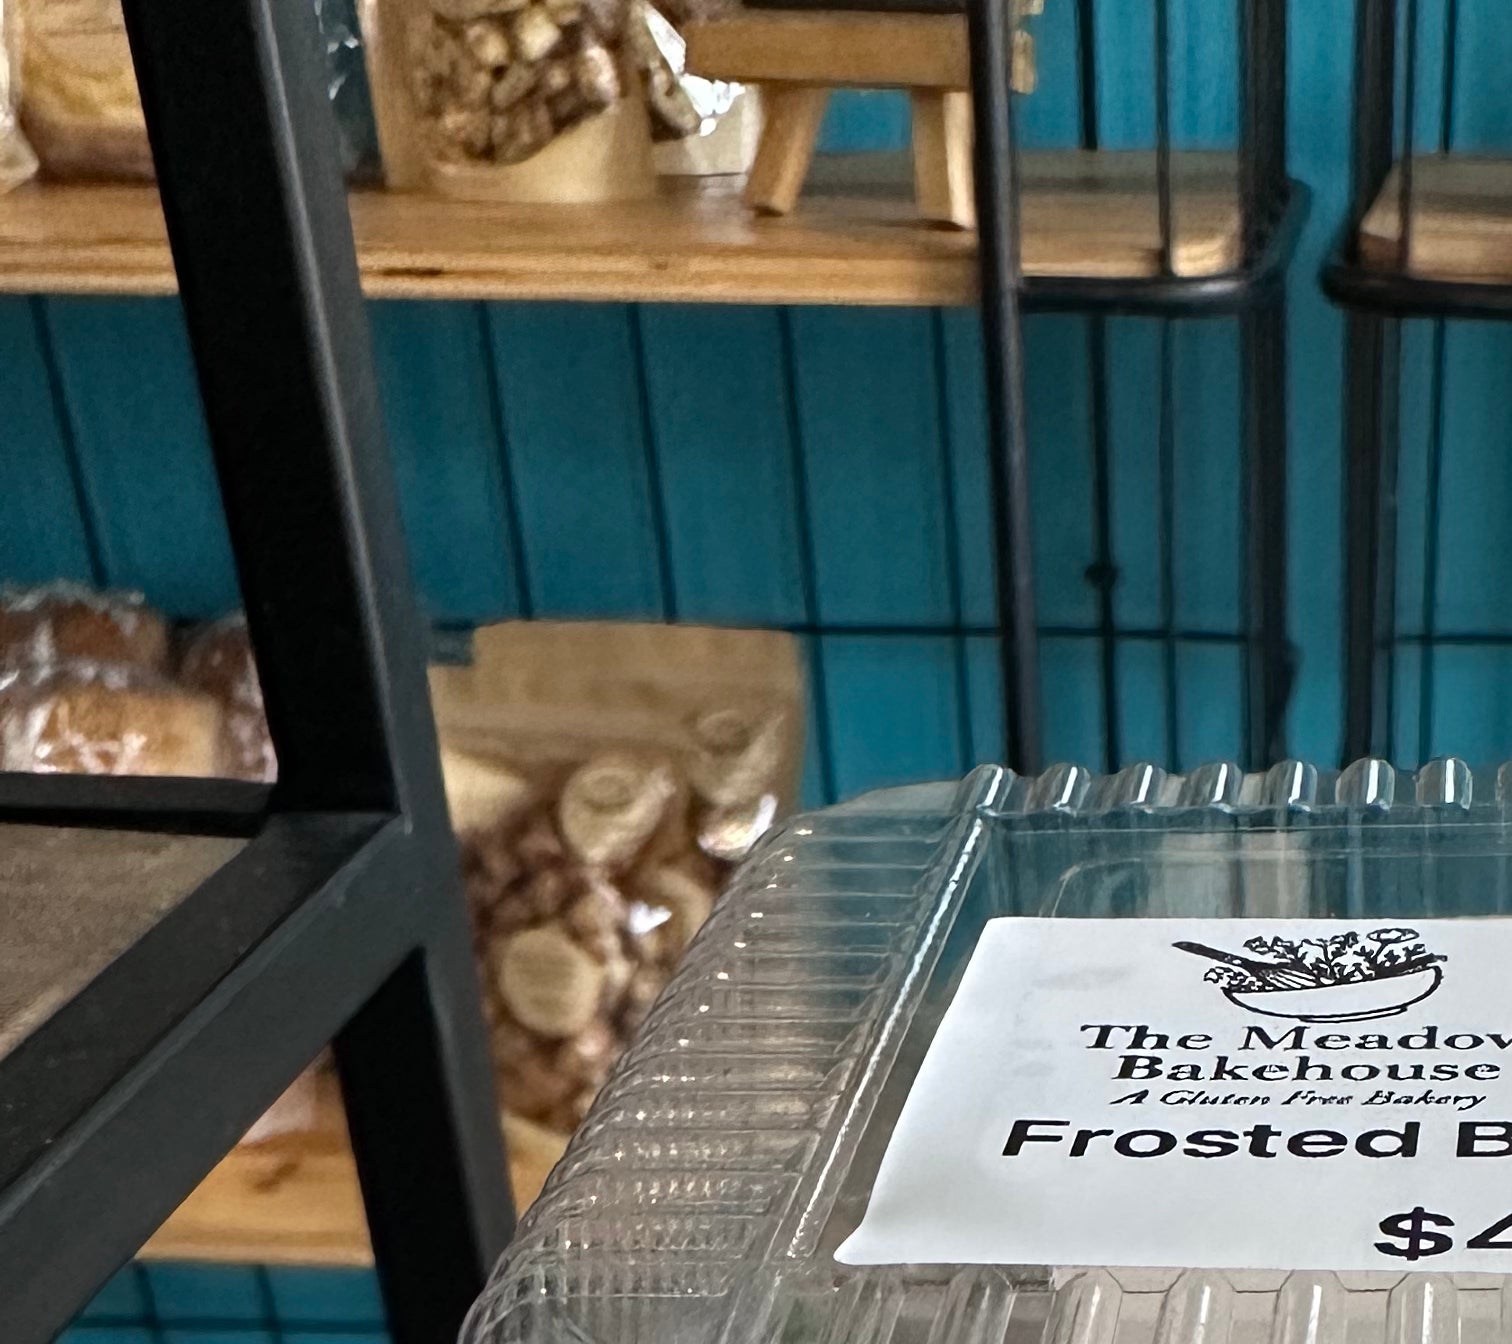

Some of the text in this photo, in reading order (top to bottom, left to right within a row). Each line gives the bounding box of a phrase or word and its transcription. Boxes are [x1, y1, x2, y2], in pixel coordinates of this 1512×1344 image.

[1080, 1024, 1213, 1051] The
[1111, 1054, 1501, 1082] Bakehouse
[1109, 1089, 1487, 1112] A Gluten Free Bakery
[1001, 1119, 1421, 1159] Frosted
